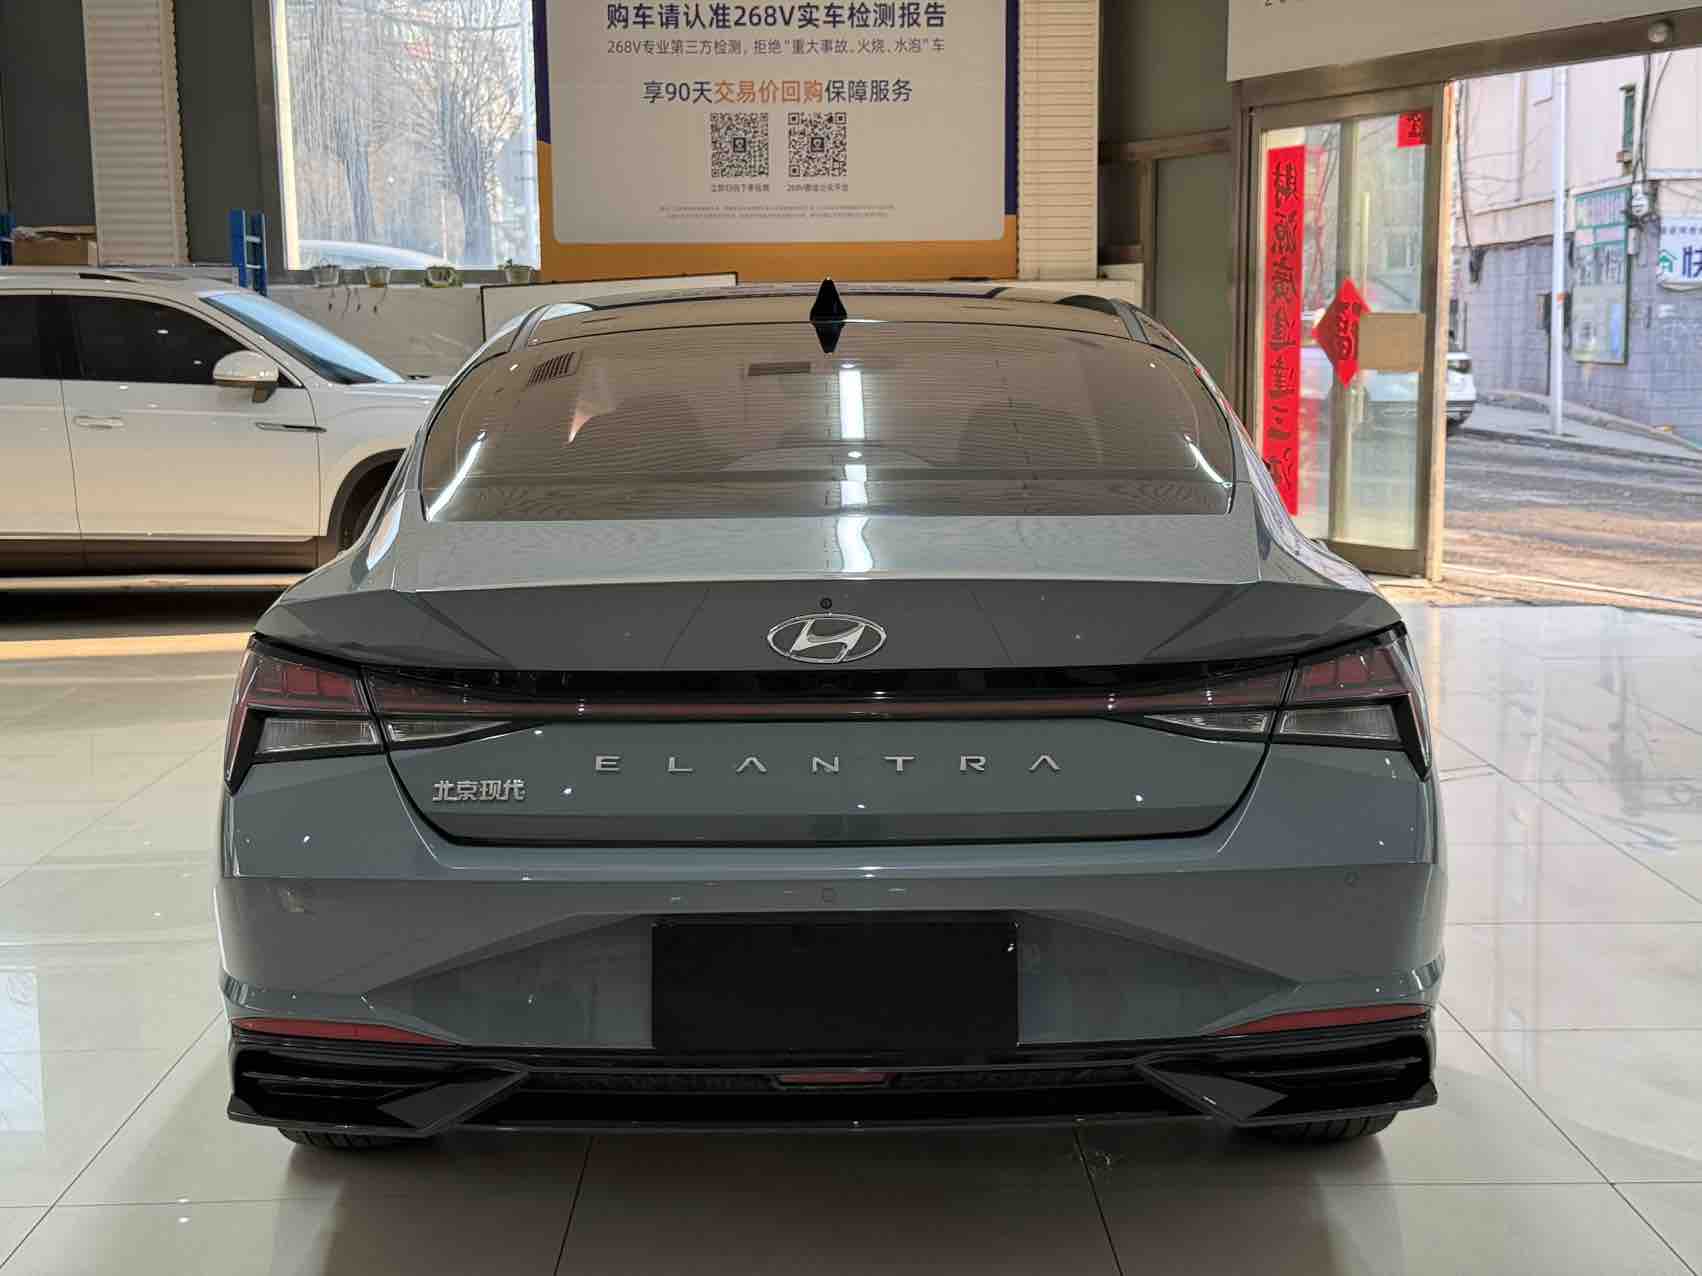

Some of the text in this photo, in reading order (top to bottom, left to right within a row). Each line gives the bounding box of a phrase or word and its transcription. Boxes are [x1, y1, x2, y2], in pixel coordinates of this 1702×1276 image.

[607, 2, 947, 29] 购车请认准268V实车检测报告
[643, 79, 913, 104] 享90天交易价回购保障服务
[594, 755, 1061, 773] ELANTRA
[432, 779, 526, 801] 北京现代
